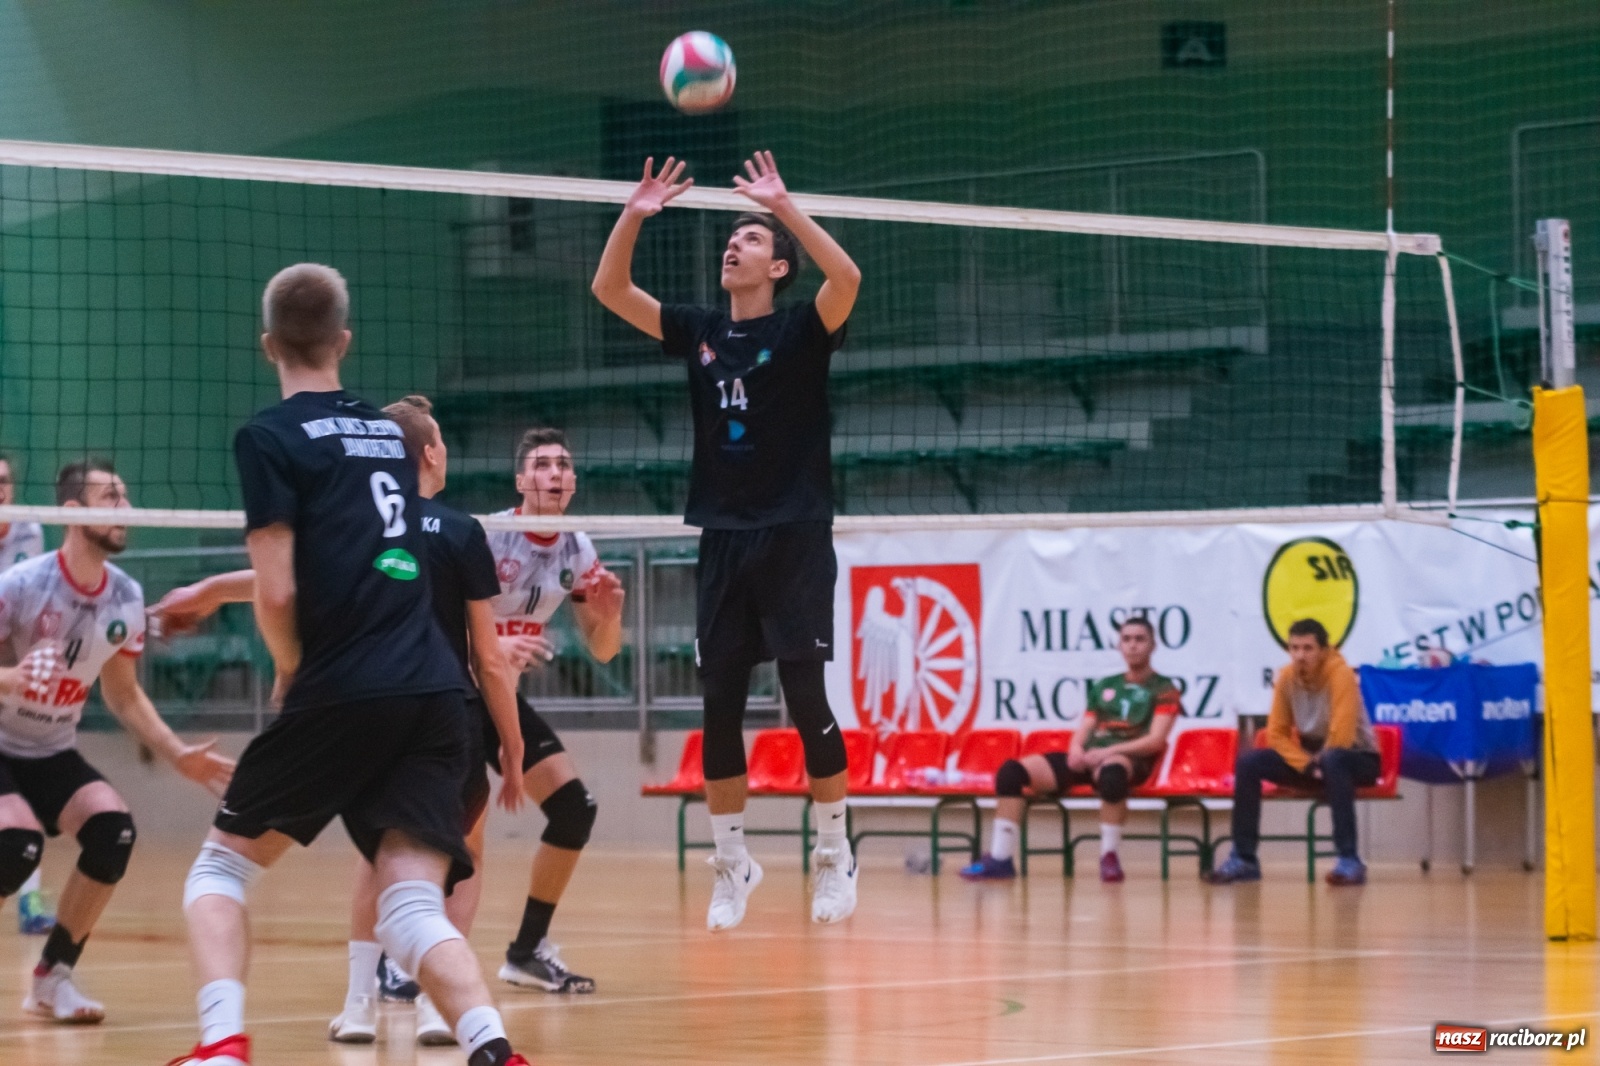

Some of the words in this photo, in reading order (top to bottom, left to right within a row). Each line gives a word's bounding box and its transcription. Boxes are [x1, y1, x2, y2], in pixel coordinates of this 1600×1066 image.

[717, 378, 749, 410] 14
[369, 471, 407, 538] 6
[420, 516, 441, 534] KA
[525, 584, 541, 615] 11
[1458, 611, 1486, 645] W
[64, 638, 83, 671] 4
[993, 675, 1222, 721] RACRZ
